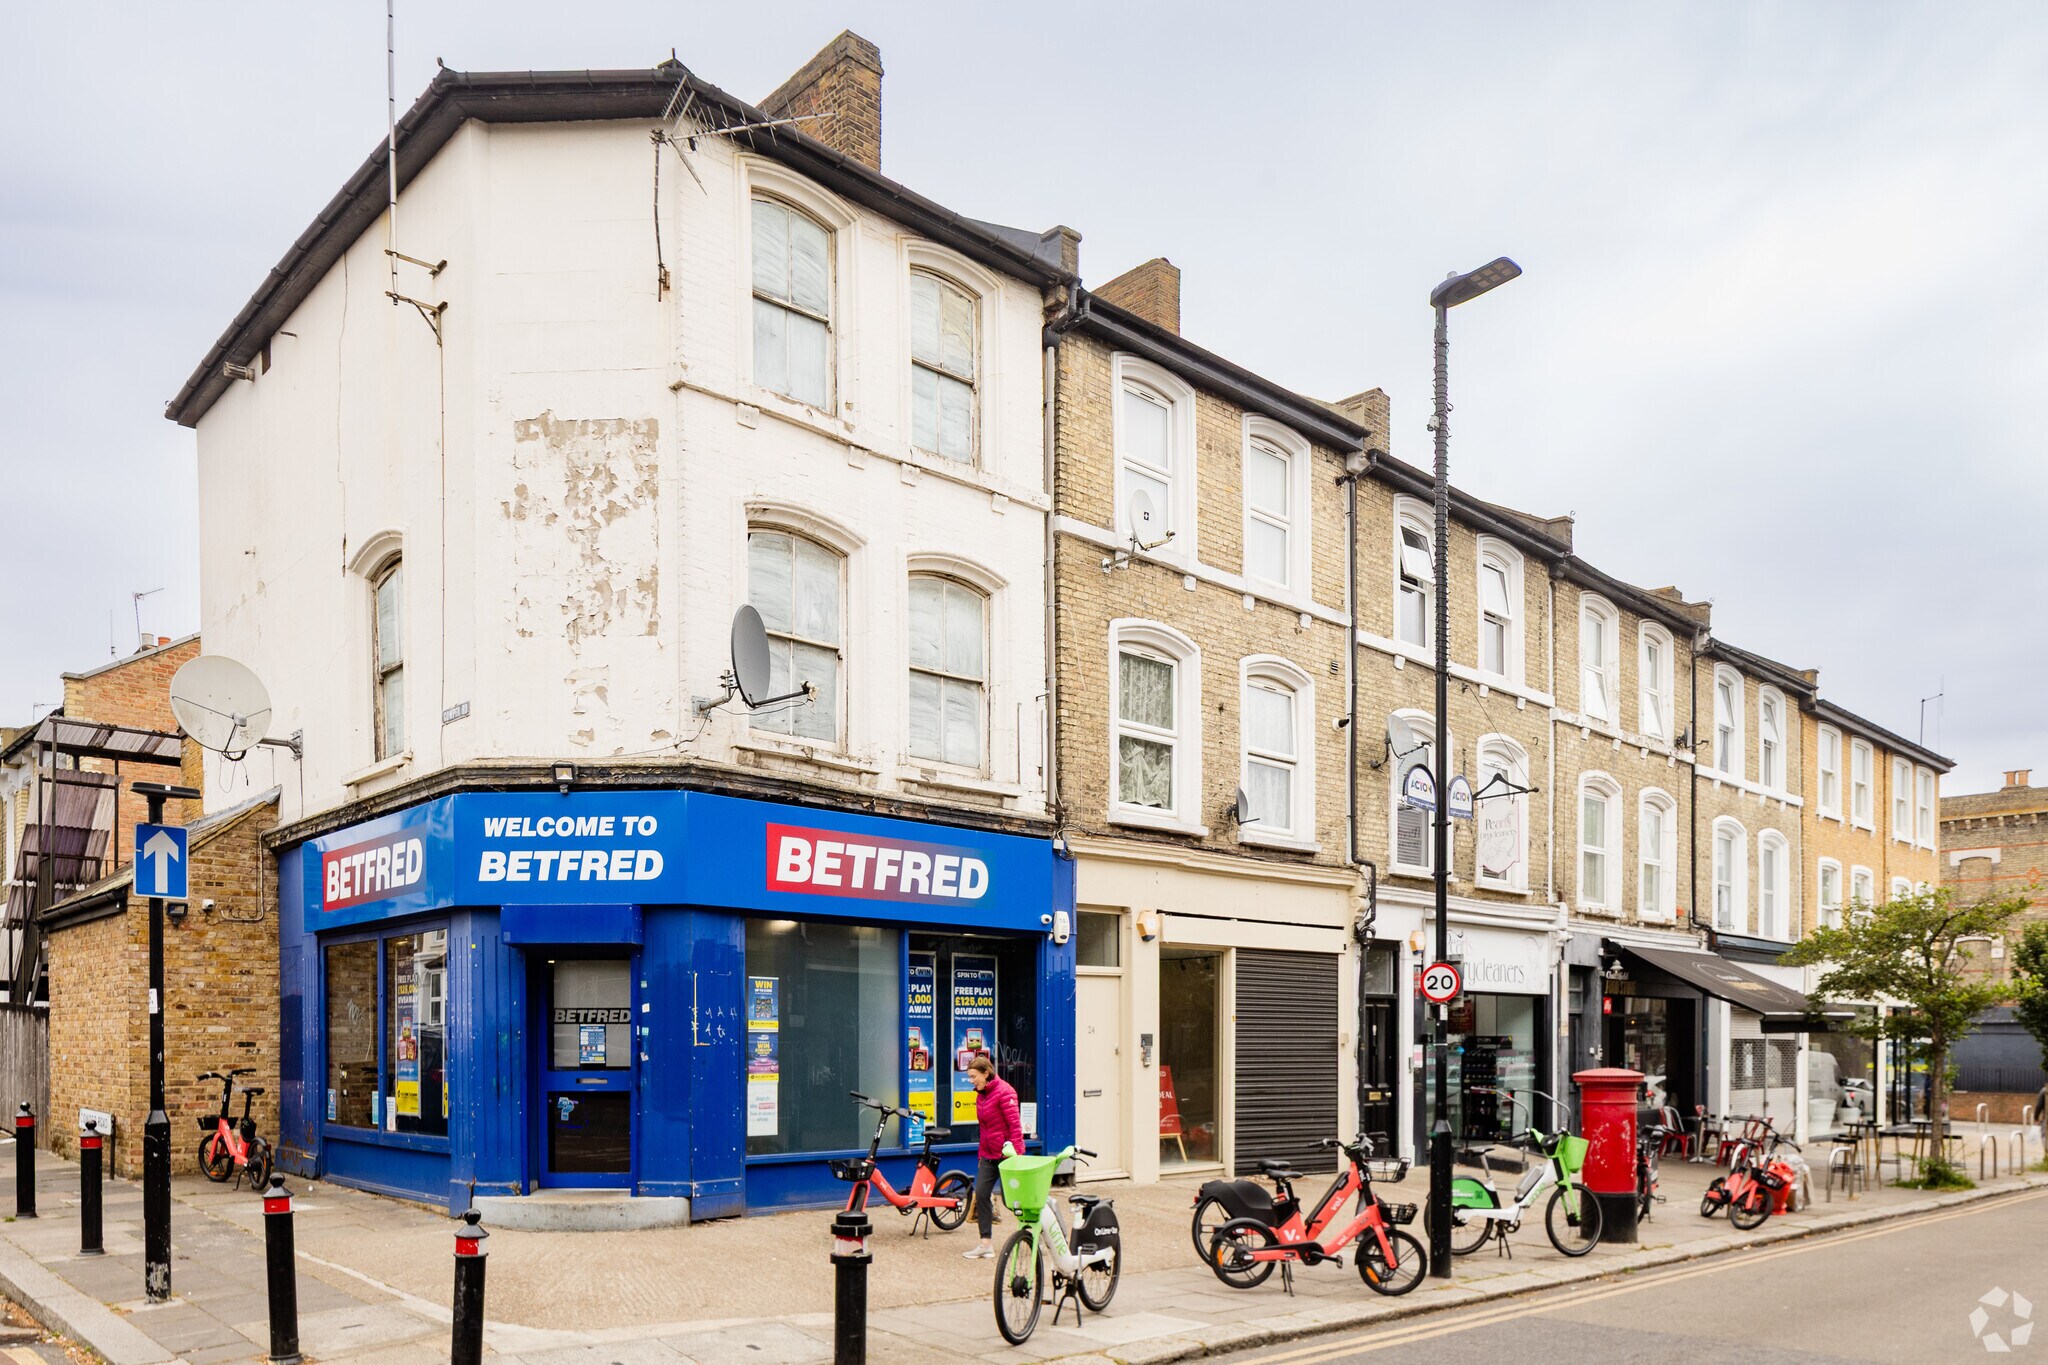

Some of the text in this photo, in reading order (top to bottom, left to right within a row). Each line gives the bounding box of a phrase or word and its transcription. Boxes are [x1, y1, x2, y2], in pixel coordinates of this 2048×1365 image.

[1411, 779, 1432, 794] ACTON
[1453, 790, 1469, 802] ACTON
[483, 816, 658, 837] WELCOME TO
[326, 837, 423, 902] BETFRED
[478, 850, 664, 882] BETFRED
[775, 836, 990, 899] BETFRED
[1463, 958, 1525, 986] rycleaners
[755, 980, 773, 989] WIN
[911, 984, 931, 992] PLAY
[1427, 975, 1453, 990] 20
[955, 987, 993, 996] FREE PLAY
[955, 997, 993, 1007] £125,000
[554, 1009, 631, 1023] BETFRED
[955, 1007, 993, 1016] GIVEAWAY
[1088, 1025, 1095, 1034] 24
[922, 1183, 933, 1195] V.
[1331, 1196, 1345, 1211] voi.
[1284, 1229, 1301, 1242] V.
